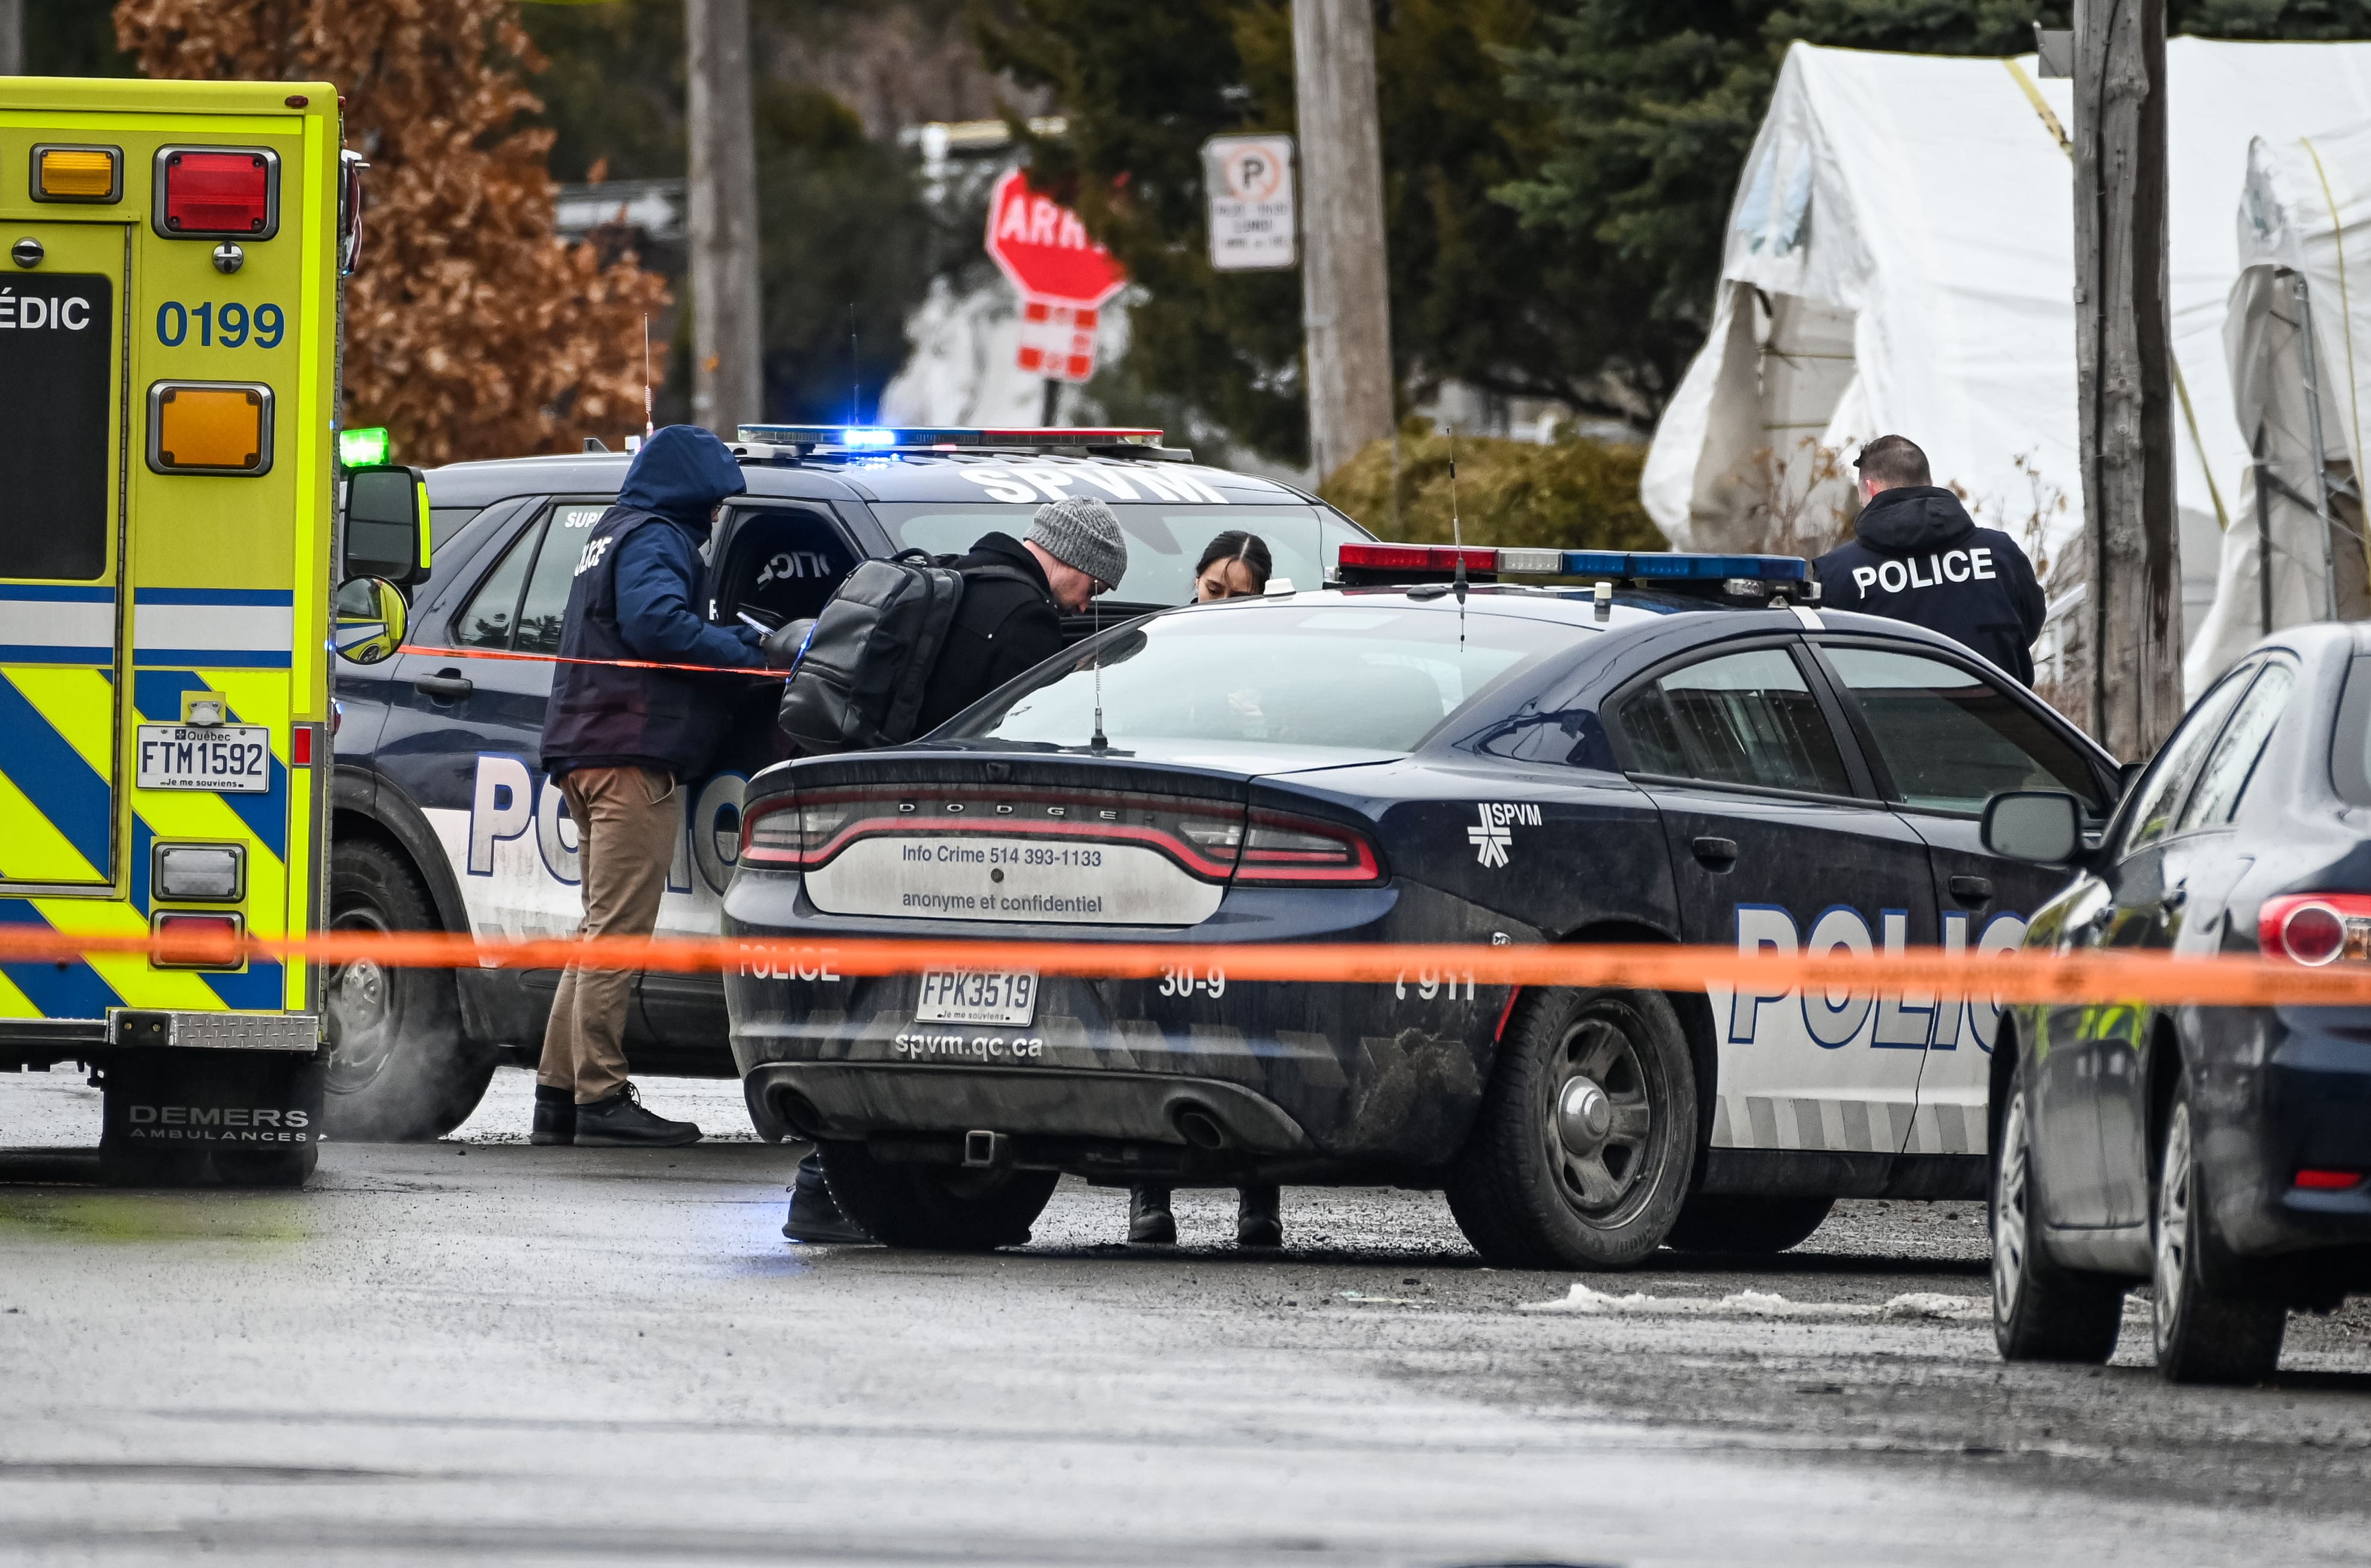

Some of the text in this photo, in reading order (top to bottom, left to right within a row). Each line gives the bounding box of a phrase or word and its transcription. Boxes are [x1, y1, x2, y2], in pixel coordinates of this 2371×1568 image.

[156, 301, 285, 349] 0199
[959, 468, 1230, 504] SPVM
[1852, 548, 1996, 599] POLICE
[187, 730, 231, 741] Québec
[142, 741, 263, 776] FTM1592
[899, 803, 1117, 821] DODGE
[1492, 803, 1543, 826] SPVM
[902, 845, 1102, 867] Info Crime 514 393-1133
[902, 893, 1102, 912] anonyme et confidentiel
[740, 944, 840, 981] POLICE
[922, 971, 1032, 1008] FPK3519
[1159, 963, 1225, 999] 30-9
[894, 1034, 1043, 1062] spvm.qc.ca
[129, 1105, 309, 1128] DEMERS
[130, 1128, 306, 1142] AMBULANCES
